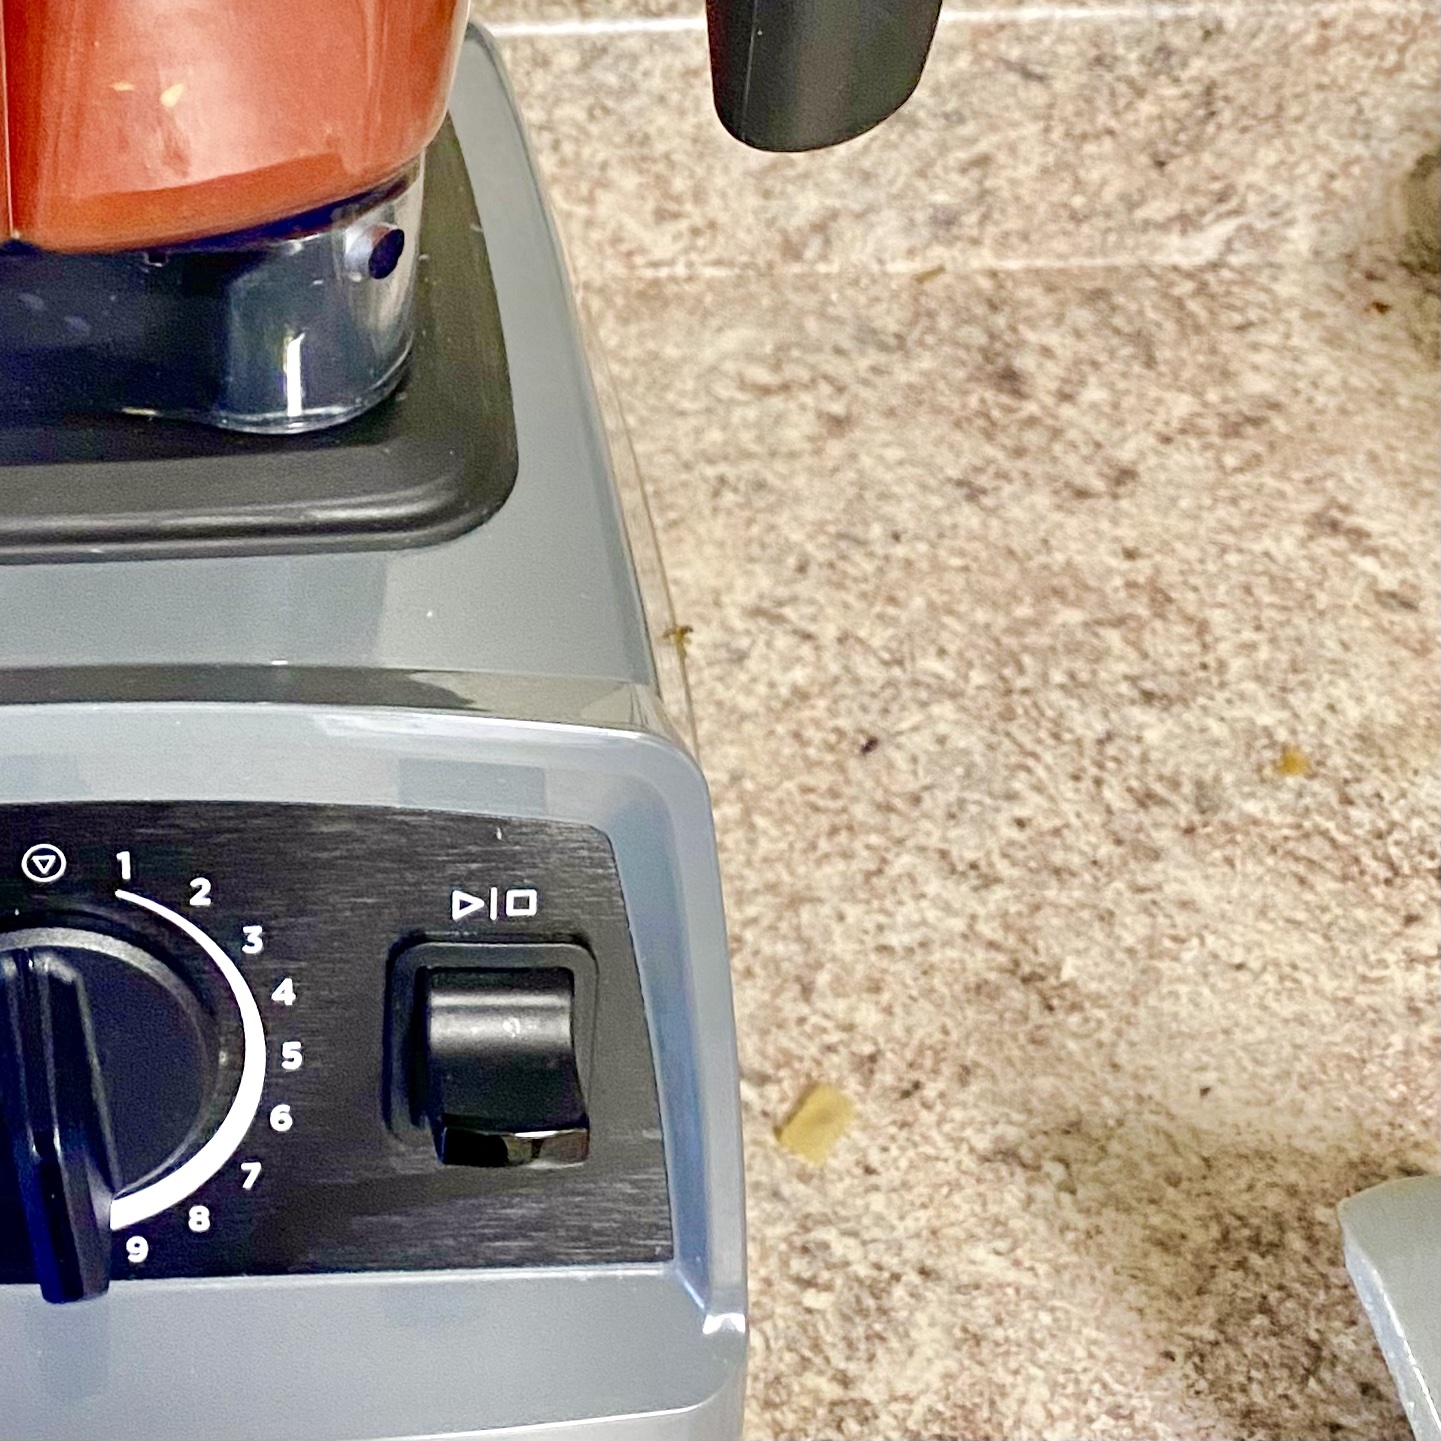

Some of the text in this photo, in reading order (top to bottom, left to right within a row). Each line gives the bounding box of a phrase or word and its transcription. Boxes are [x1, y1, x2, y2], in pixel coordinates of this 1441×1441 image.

[116, 851, 131, 880] 1
[189, 877, 212, 907] 2
[242, 925, 264, 955] 3
[271, 977, 297, 1006] 4
[282, 1041, 303, 1071] 5
[269, 1104, 294, 1132] 6
[241, 1162, 262, 1190] 7
[188, 1205, 211, 1233] 8
[125, 1236, 149, 1264] 9
